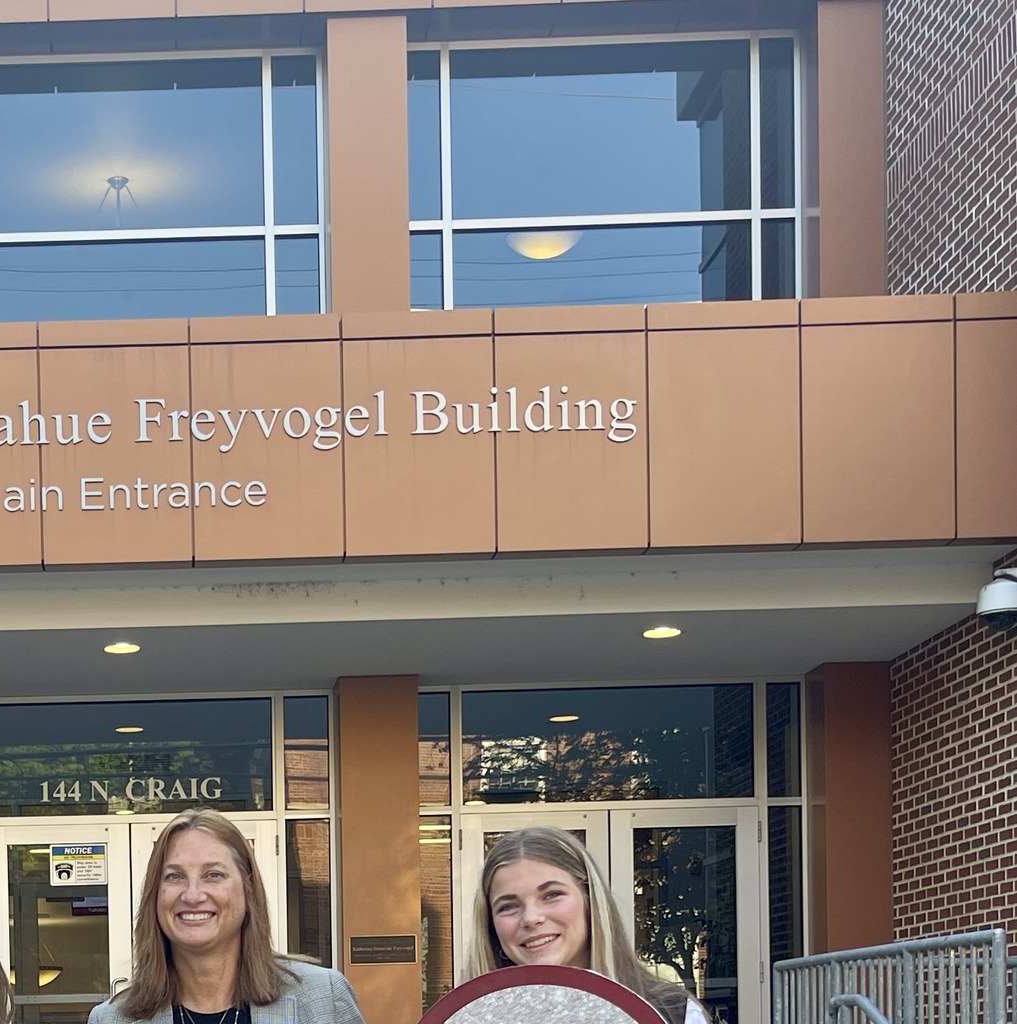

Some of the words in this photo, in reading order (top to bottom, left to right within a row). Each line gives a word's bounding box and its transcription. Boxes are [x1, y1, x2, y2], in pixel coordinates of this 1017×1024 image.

[134, 390, 389, 453] Freyvogel
[410, 385, 638, 443] Building
[80, 477, 268, 511] Entrance
[39, 780, 82, 803] 144
[89, 780, 117, 801] N.
[125, 776, 223, 801] CRAIG
[64, 847, 93, 855] NOTICE
